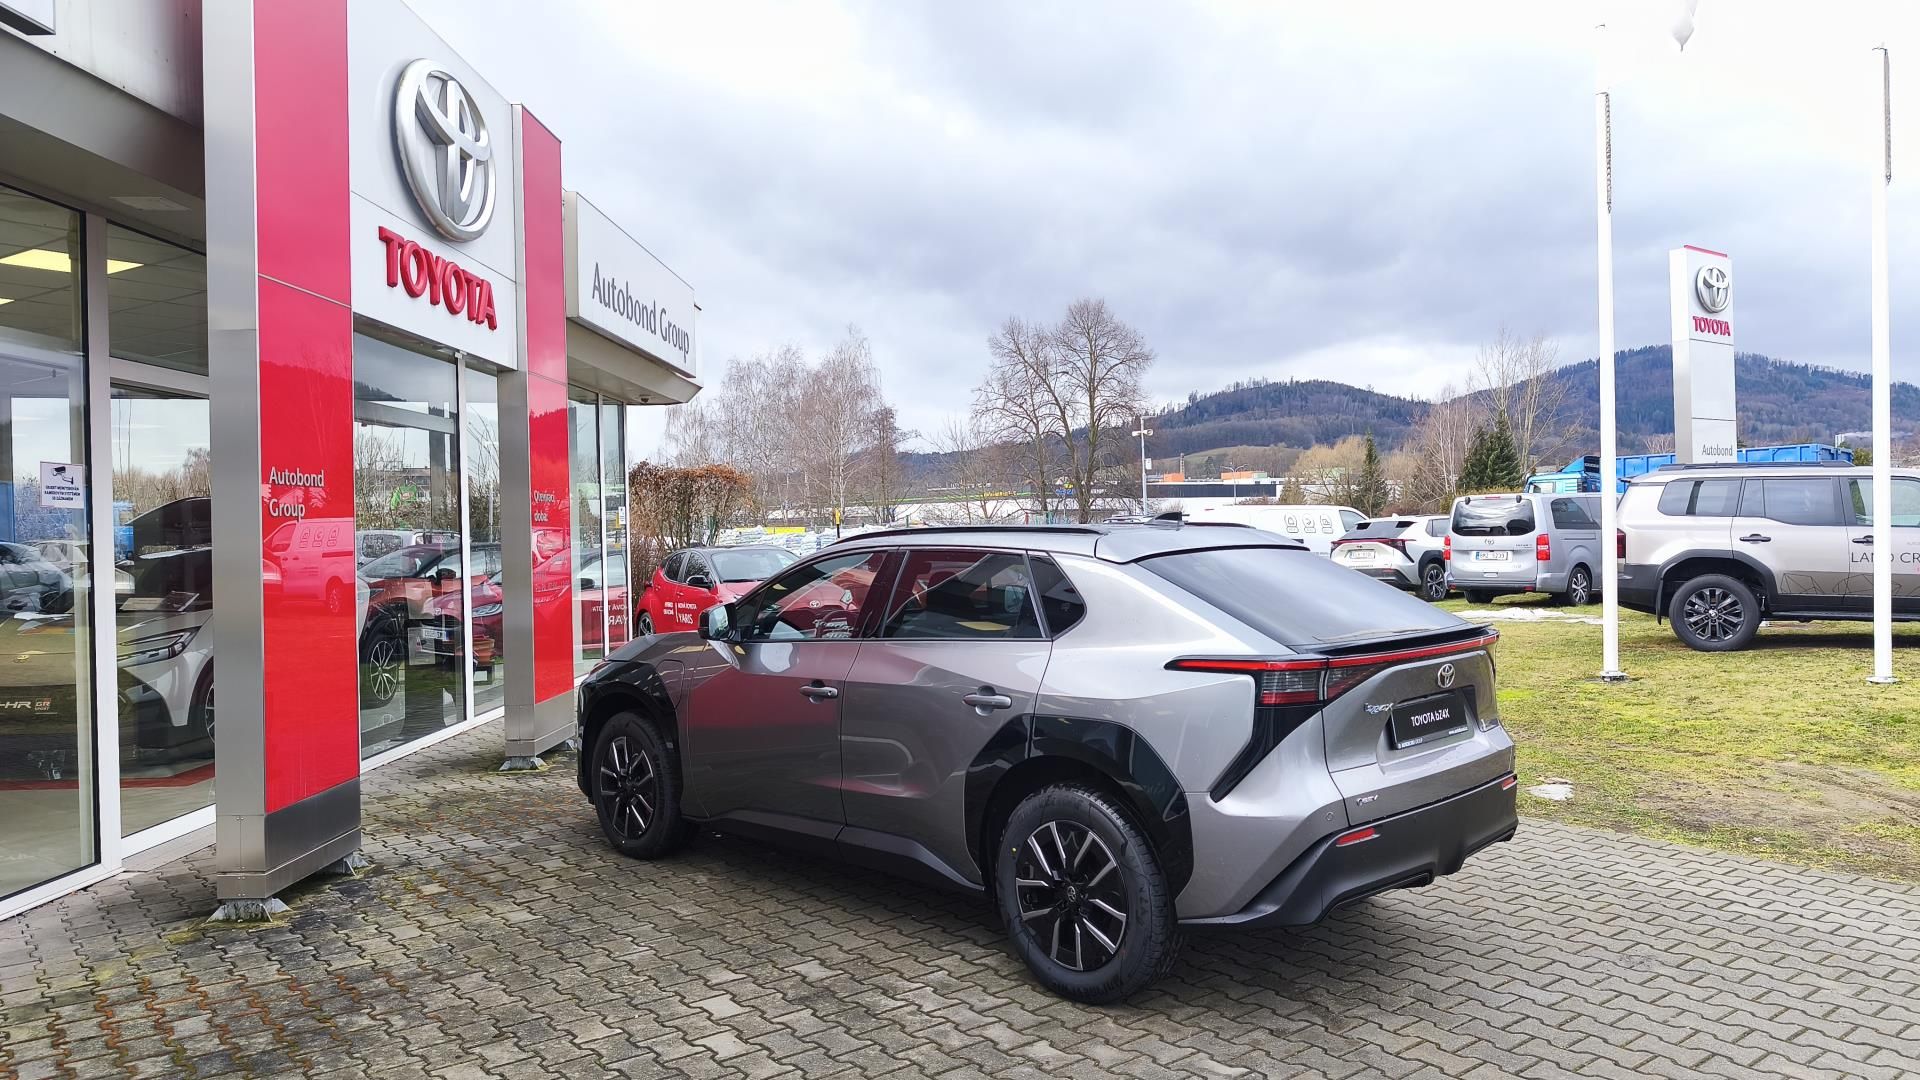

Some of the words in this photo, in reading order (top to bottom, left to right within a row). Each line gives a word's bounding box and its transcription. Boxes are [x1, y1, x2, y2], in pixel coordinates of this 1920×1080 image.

[378, 225, 498, 331] TOYOTA
[592, 262, 657, 335] Autobond
[659, 303, 690, 364] Group
[1692, 315, 1731, 337] TOYOTA
[1701, 443, 1733, 457] Autobond
[269, 466, 325, 487] Autobond
[269, 498, 306, 523] Group
[1851, 552, 1895, 563] LA
[678, 613, 694, 625] YARIS
[1410, 712, 1435, 727] TOYOTA
[1435, 708, 1450, 721] bZ4X
